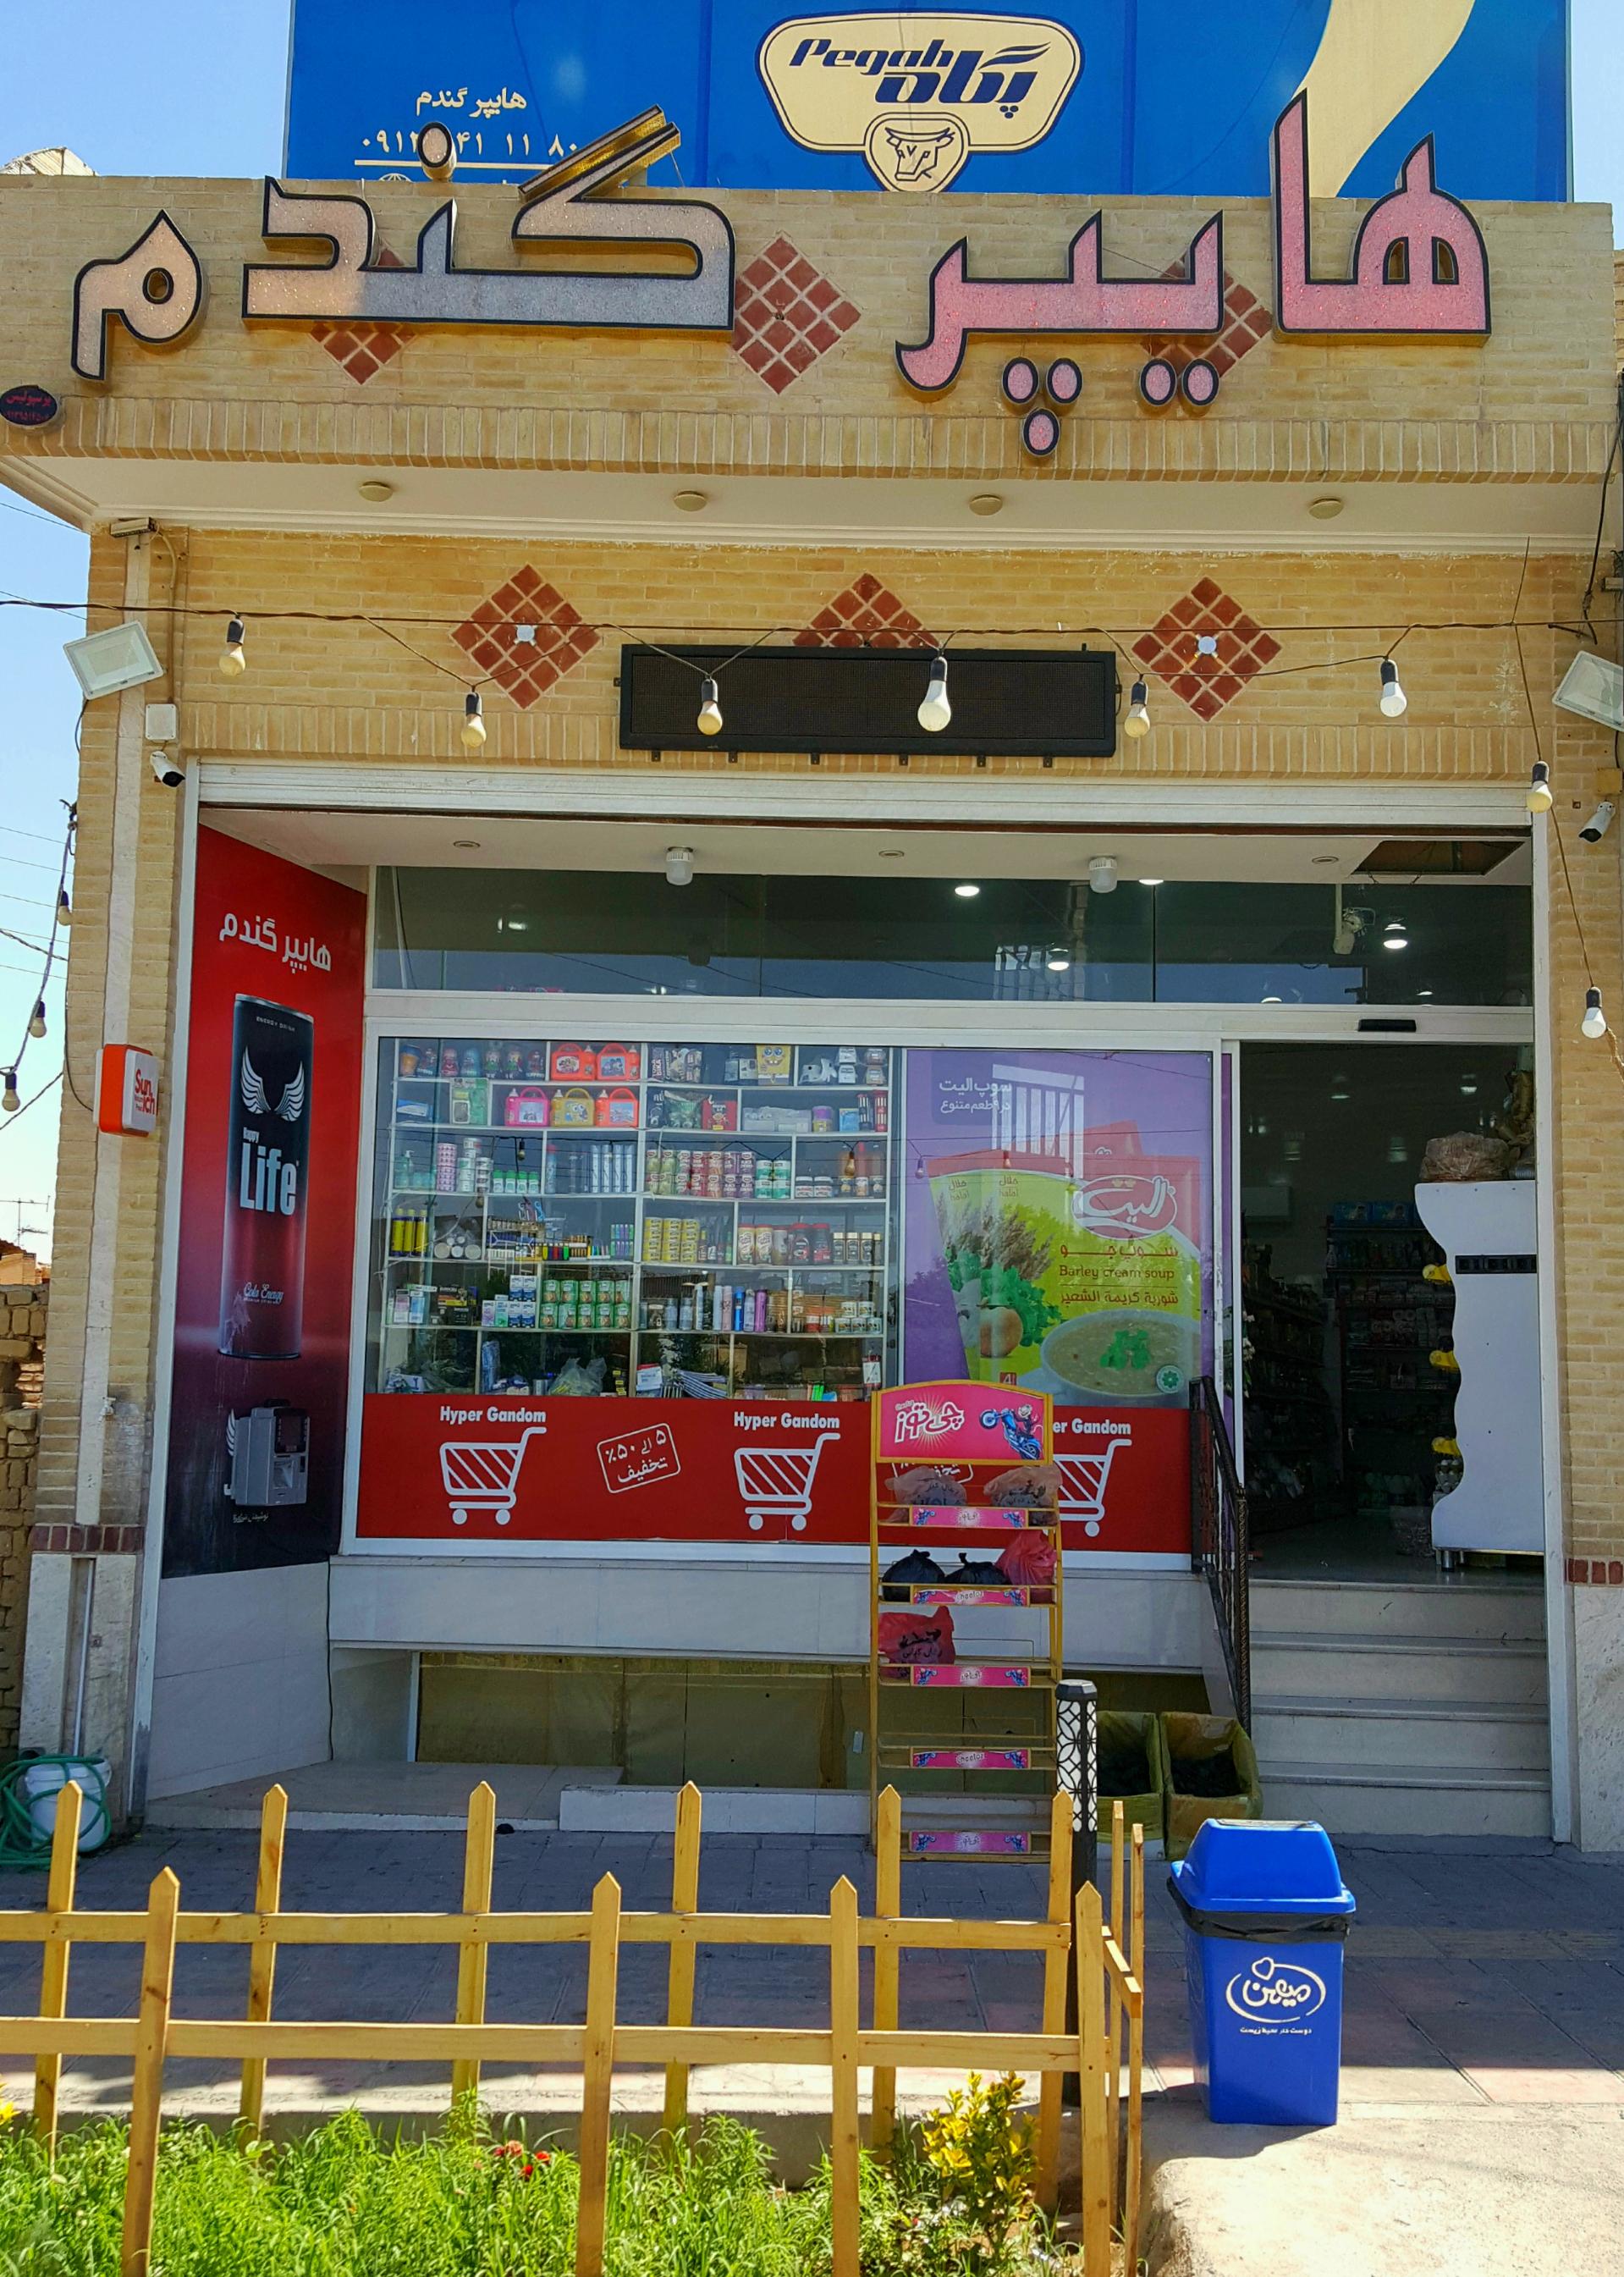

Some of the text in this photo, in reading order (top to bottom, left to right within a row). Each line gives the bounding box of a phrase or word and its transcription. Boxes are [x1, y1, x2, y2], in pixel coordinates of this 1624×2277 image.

[789, 39, 955, 75] Pegah
[874, 41, 1052, 119] پگاه
[416, 87, 527, 119] هایپر گندم
[70, 89, 1492, 458] هایپر گندم
[219, 913, 331, 974] هایپر گندم
[939, 1077, 973, 1096] الیت
[940, 1100, 971, 1114] متنوع
[239, 1143, 297, 1216] Life
[1059, 1265, 1175, 1282] Barley cream soup
[440, 1405, 547, 1425] Hyper Gandom
[734, 1411, 840, 1431] Hyper Gandom
[1071, 1418, 1131, 1435] Gandom
[617, 1456, 669, 1483] تخفیف
[1242, 1979, 1312, 2007] میهن
